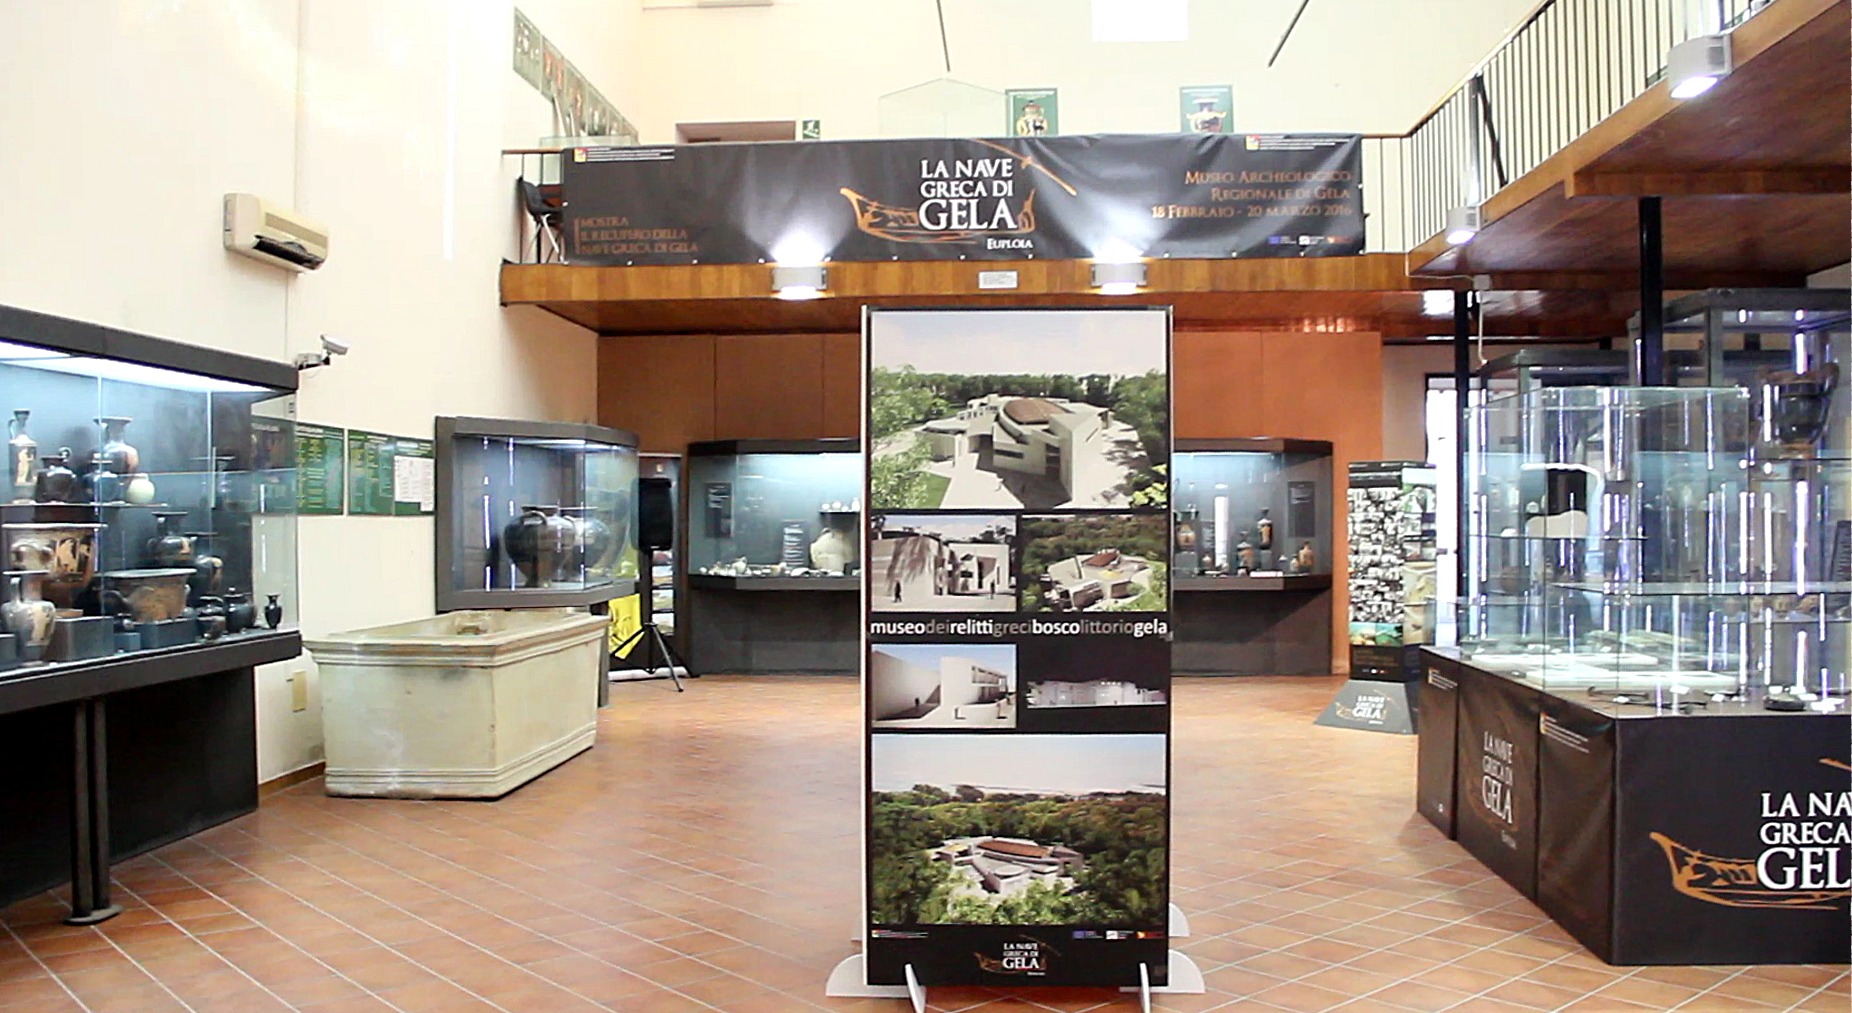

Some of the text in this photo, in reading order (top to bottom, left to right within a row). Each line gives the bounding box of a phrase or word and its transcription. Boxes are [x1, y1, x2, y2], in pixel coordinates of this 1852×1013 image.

[921, 158, 1014, 178] LA NAVE
[920, 180, 1014, 198] GRECA DI
[919, 198, 1018, 230] GELA
[1483, 775, 1513, 824] GELA
[1761, 791, 1852, 817] LA NA
[1760, 821, 1851, 845] GRECA
[1002, 957, 1040, 969] GELA
